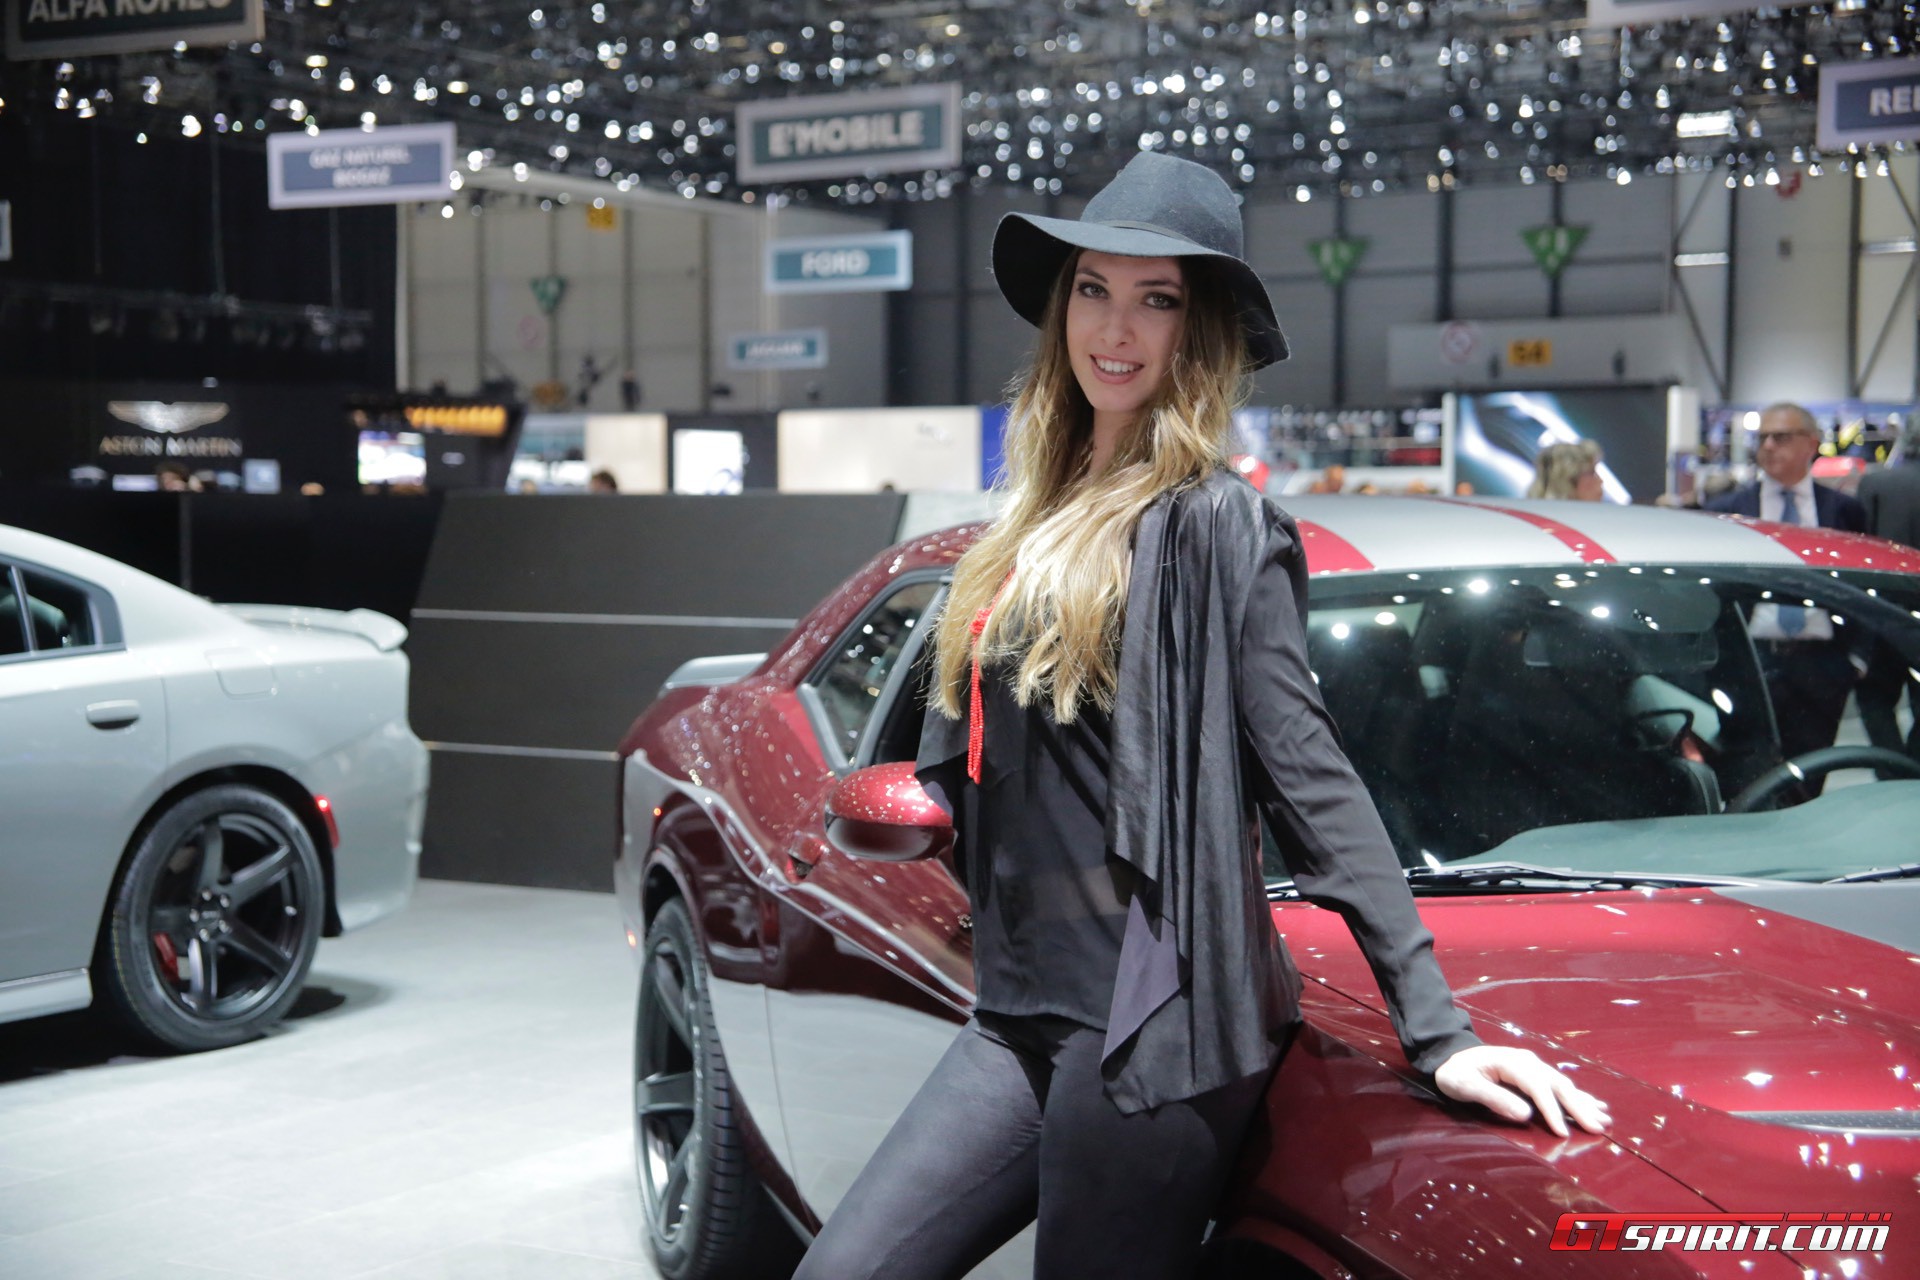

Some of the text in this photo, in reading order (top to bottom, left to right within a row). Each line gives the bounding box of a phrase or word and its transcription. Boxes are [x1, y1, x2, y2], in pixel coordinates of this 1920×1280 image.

[801, 248, 870, 279] FORD
[100, 436, 243, 457] ASTON MARTIN
